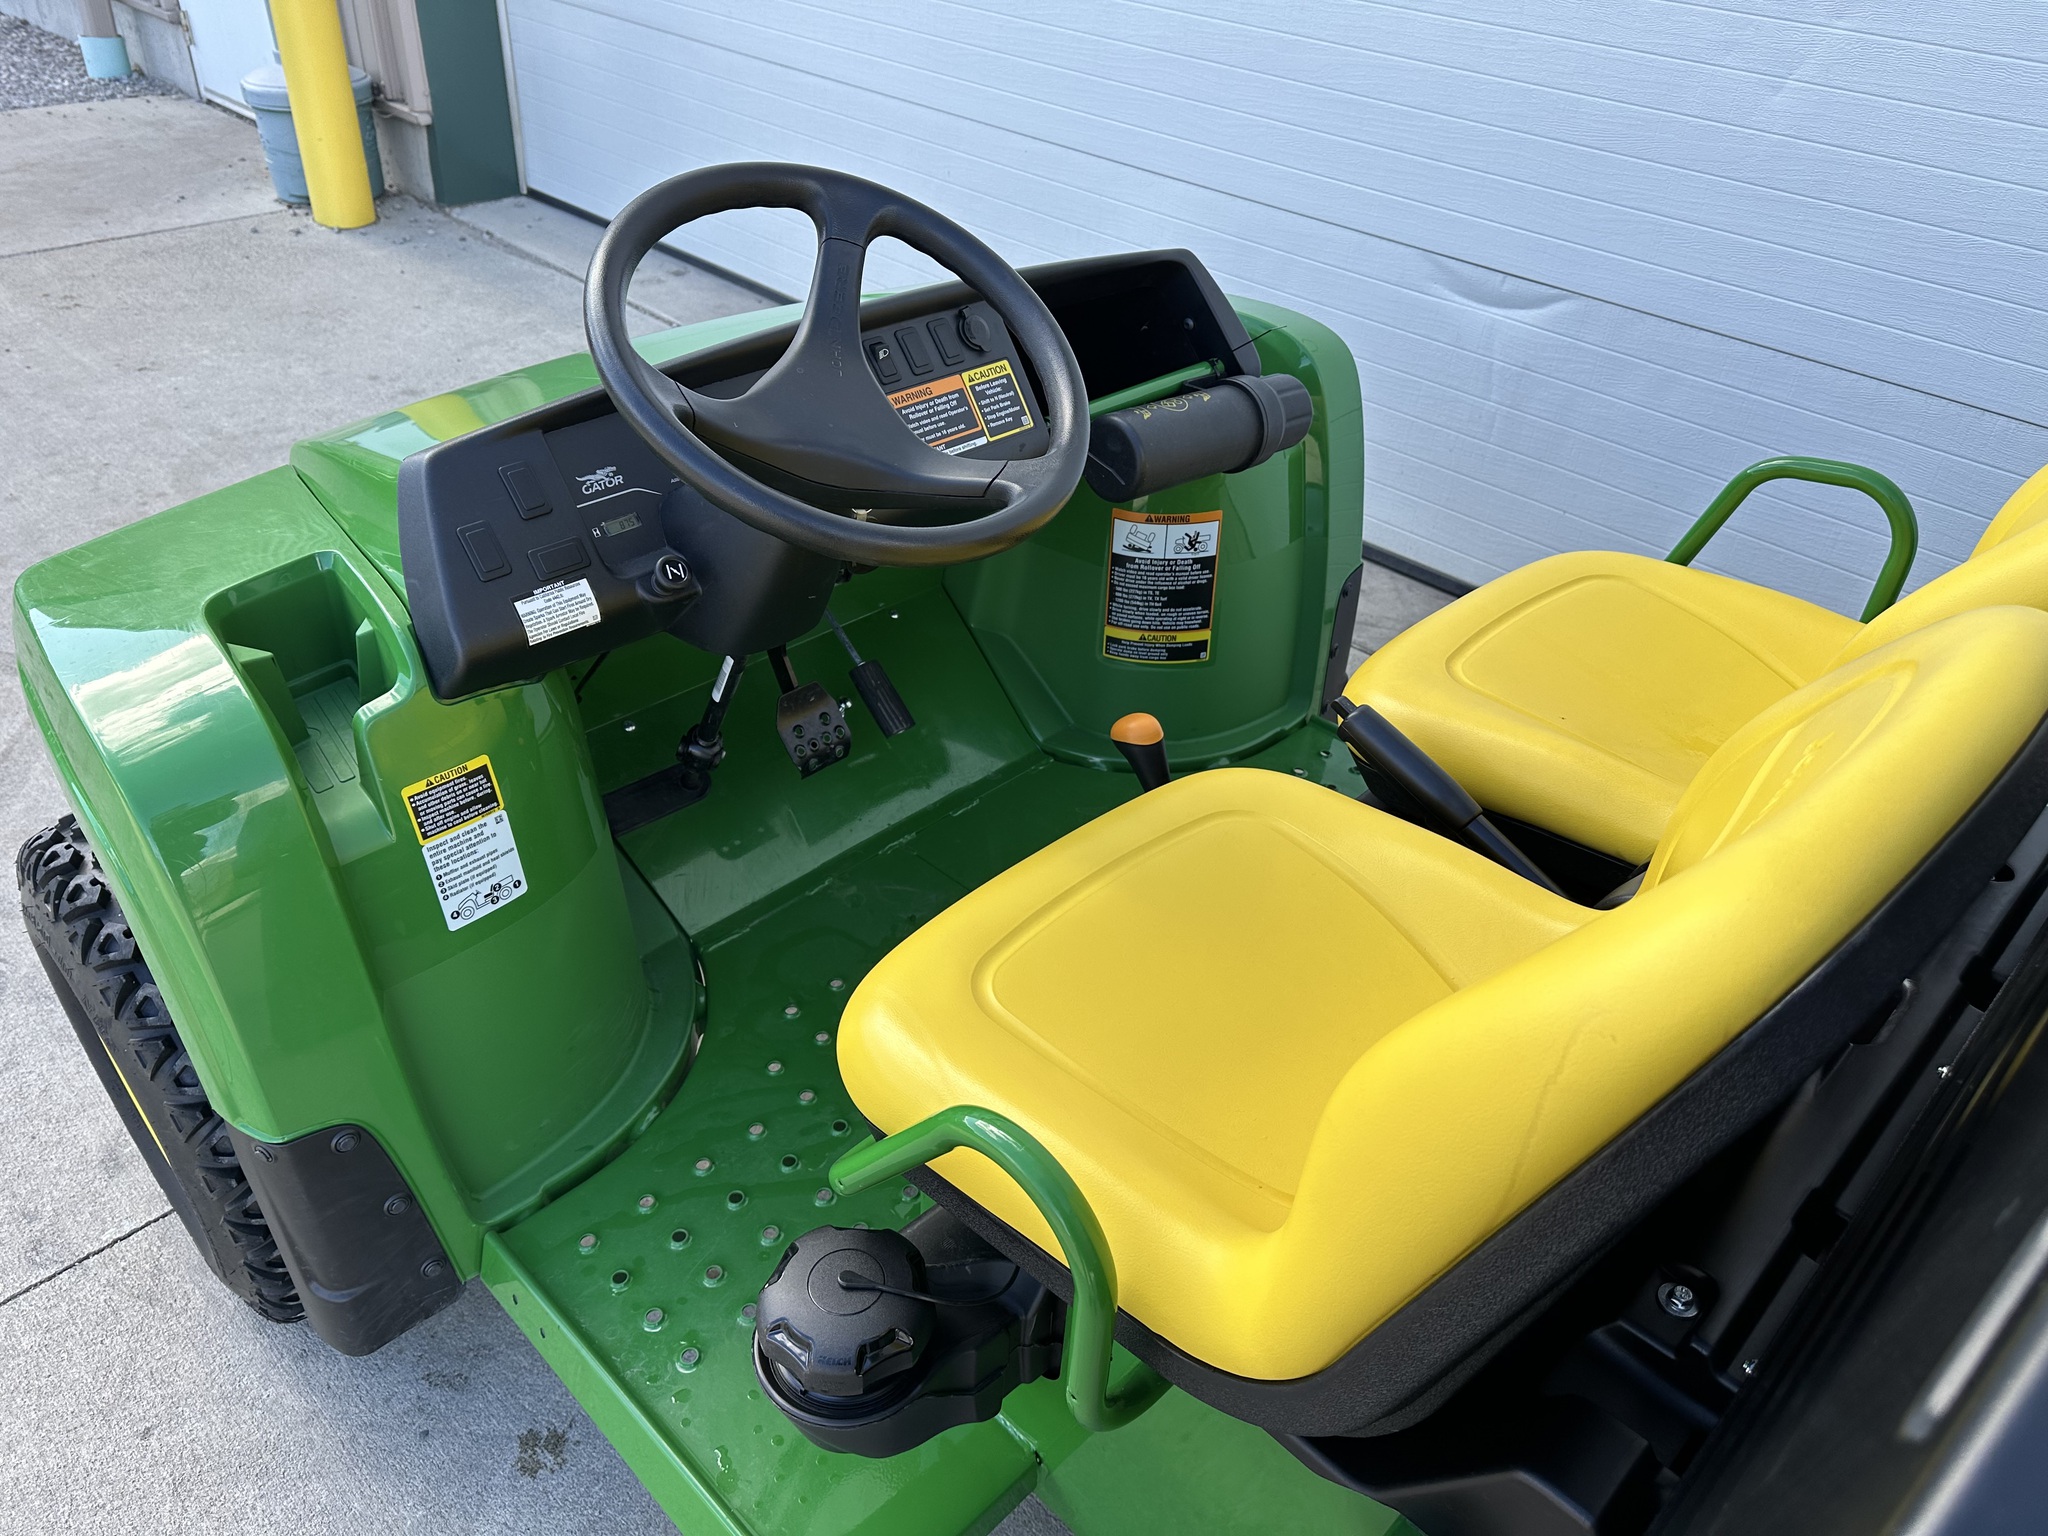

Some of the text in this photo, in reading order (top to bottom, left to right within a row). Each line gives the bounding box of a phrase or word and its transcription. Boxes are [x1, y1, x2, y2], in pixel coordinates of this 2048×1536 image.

[973, 364, 1007, 380] CAUTION
[975, 378, 1007, 391] Before Leaving
[892, 387, 932, 405] WARNING
[901, 406, 915, 414] Avoid
[934, 396, 948, 404] Death
[909, 410, 928, 419] Rollover
[934, 403, 950, 411] Falling
[582, 474, 624, 494] GATOR
[1154, 515, 1190, 523] WARNING
[665, 563, 685, 580] N
[533, 580, 565, 595] IMPORTANT
[1147, 634, 1177, 642] CAUTION
[434, 764, 468, 783] CAUTION
[426, 839, 448, 852] Inspect
[449, 833, 460, 842] and
[461, 827, 477, 837] clean
[429, 830, 484, 859] entire machine and
[431, 858, 442, 866] pay
[443, 847, 464, 860] special
[466, 836, 490, 850] attention
[433, 849, 478, 872] these locations:
